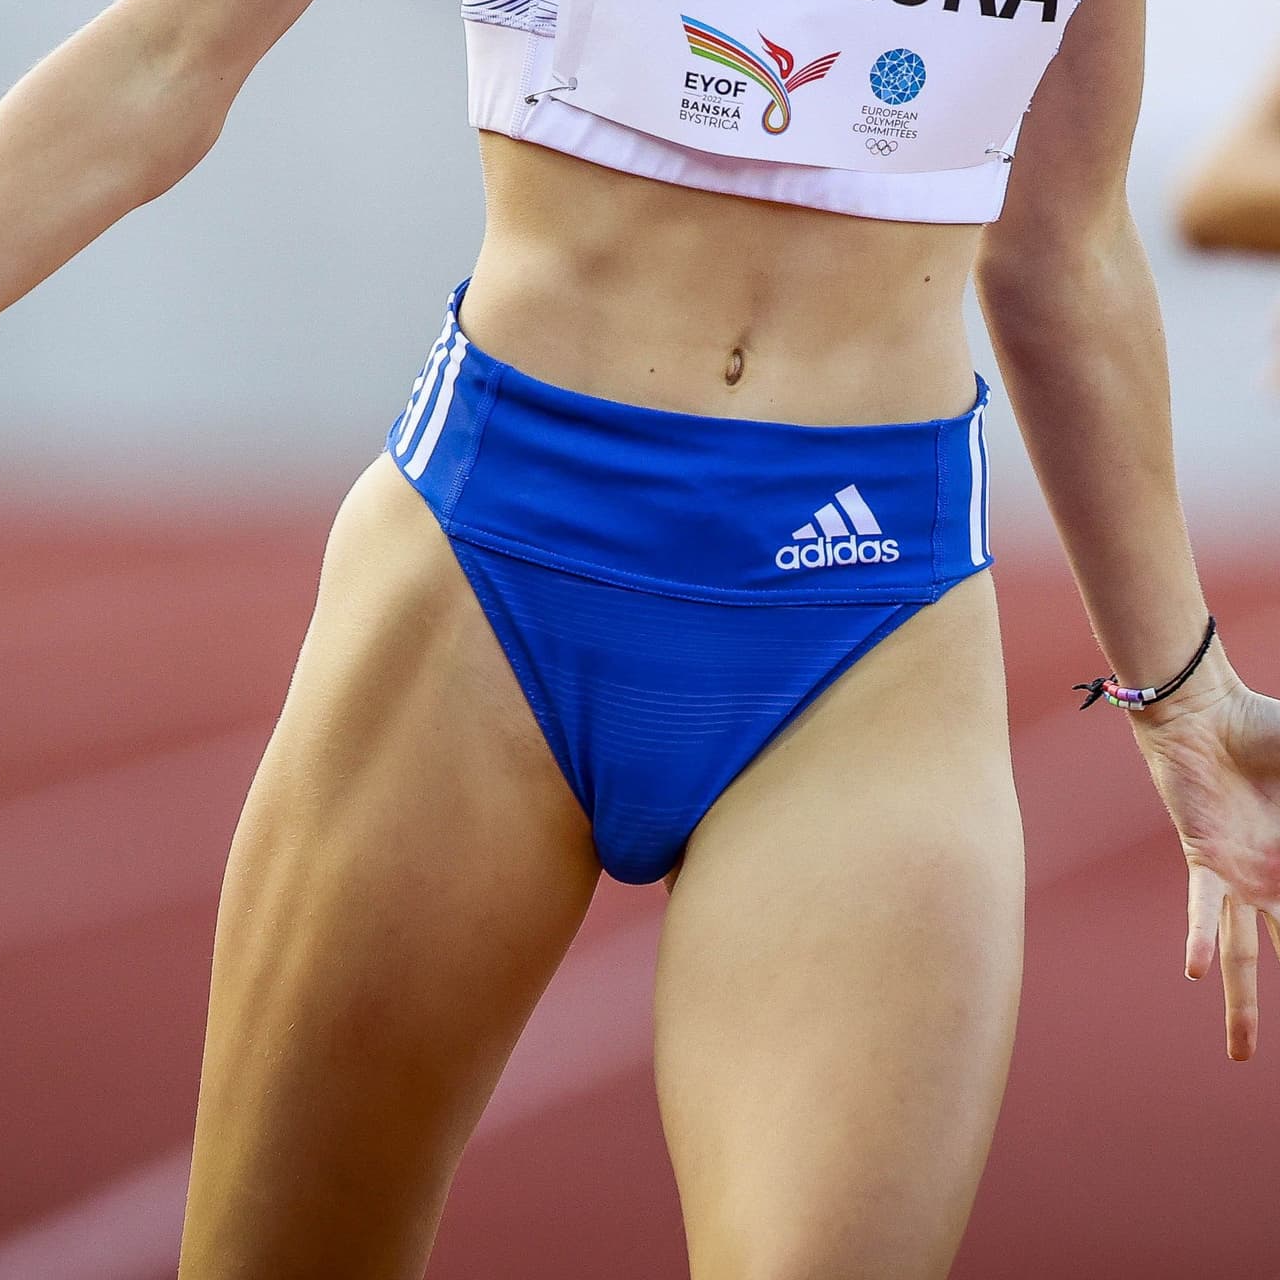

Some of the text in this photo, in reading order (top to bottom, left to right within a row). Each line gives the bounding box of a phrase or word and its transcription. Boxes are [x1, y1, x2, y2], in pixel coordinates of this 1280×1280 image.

[683, 71, 747, 98] EYOF
[680, 98, 742, 120] BANSKÁ
[861, 105, 919, 121] EUROPEAN
[678, 109, 740, 132] BYSTRICA
[865, 116, 911, 131] OLYMPIC
[852, 125, 918, 140] COMMITTEES
[775, 534, 901, 570] adidas
